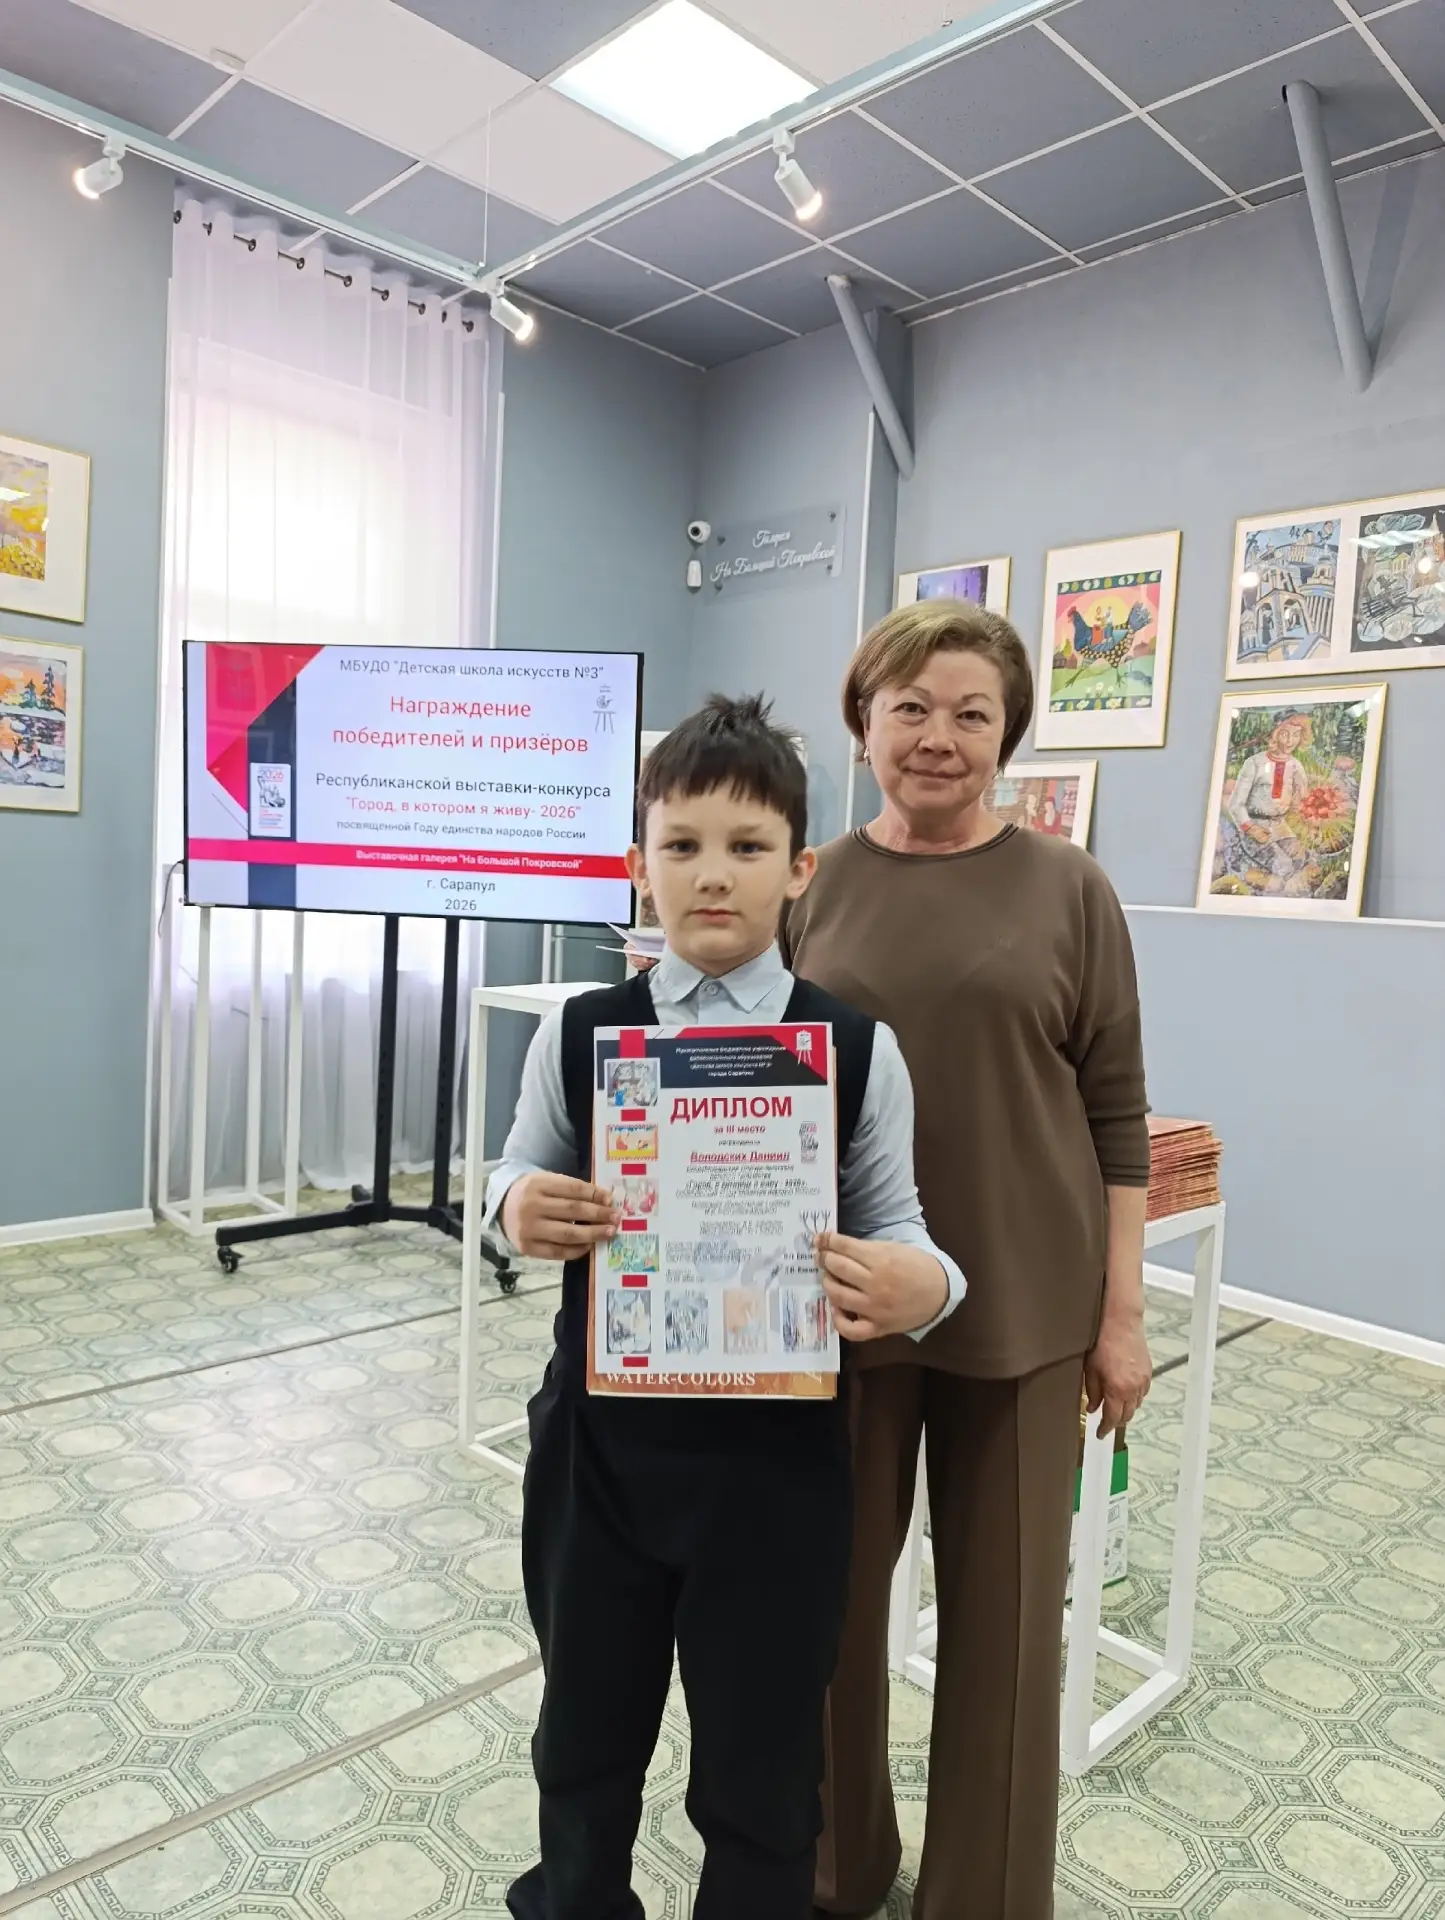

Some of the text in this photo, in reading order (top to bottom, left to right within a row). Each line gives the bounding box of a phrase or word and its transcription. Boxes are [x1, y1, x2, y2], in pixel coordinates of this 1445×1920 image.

[340, 659, 604, 679] МБУДО "Детская школа искусств №3"
[390, 696, 532, 718] Награждение
[333, 727, 589, 755] победителей и призёров
[316, 772, 611, 800] Республиканской выставки-конкурса
[401, 802, 410, 811] в
[414, 802, 476, 815] котором
[480, 805, 488, 814] я
[540, 805, 582, 819] 2026"
[336, 820, 586, 839] посвященной Году единства народов России
[356, 850, 419, 862] Выставочная
[421, 853, 457, 864] галерея
[477, 855, 520, 867] Большой
[522, 857, 583, 869] Покровской"
[427, 877, 496, 893] г. Сарапул
[445, 898, 477, 912] 2026
[670, 1096, 793, 1124] ДИПЛОМ
[738, 1125, 766, 1133] место
[606, 1371, 757, 1386] WATER-COLORS
